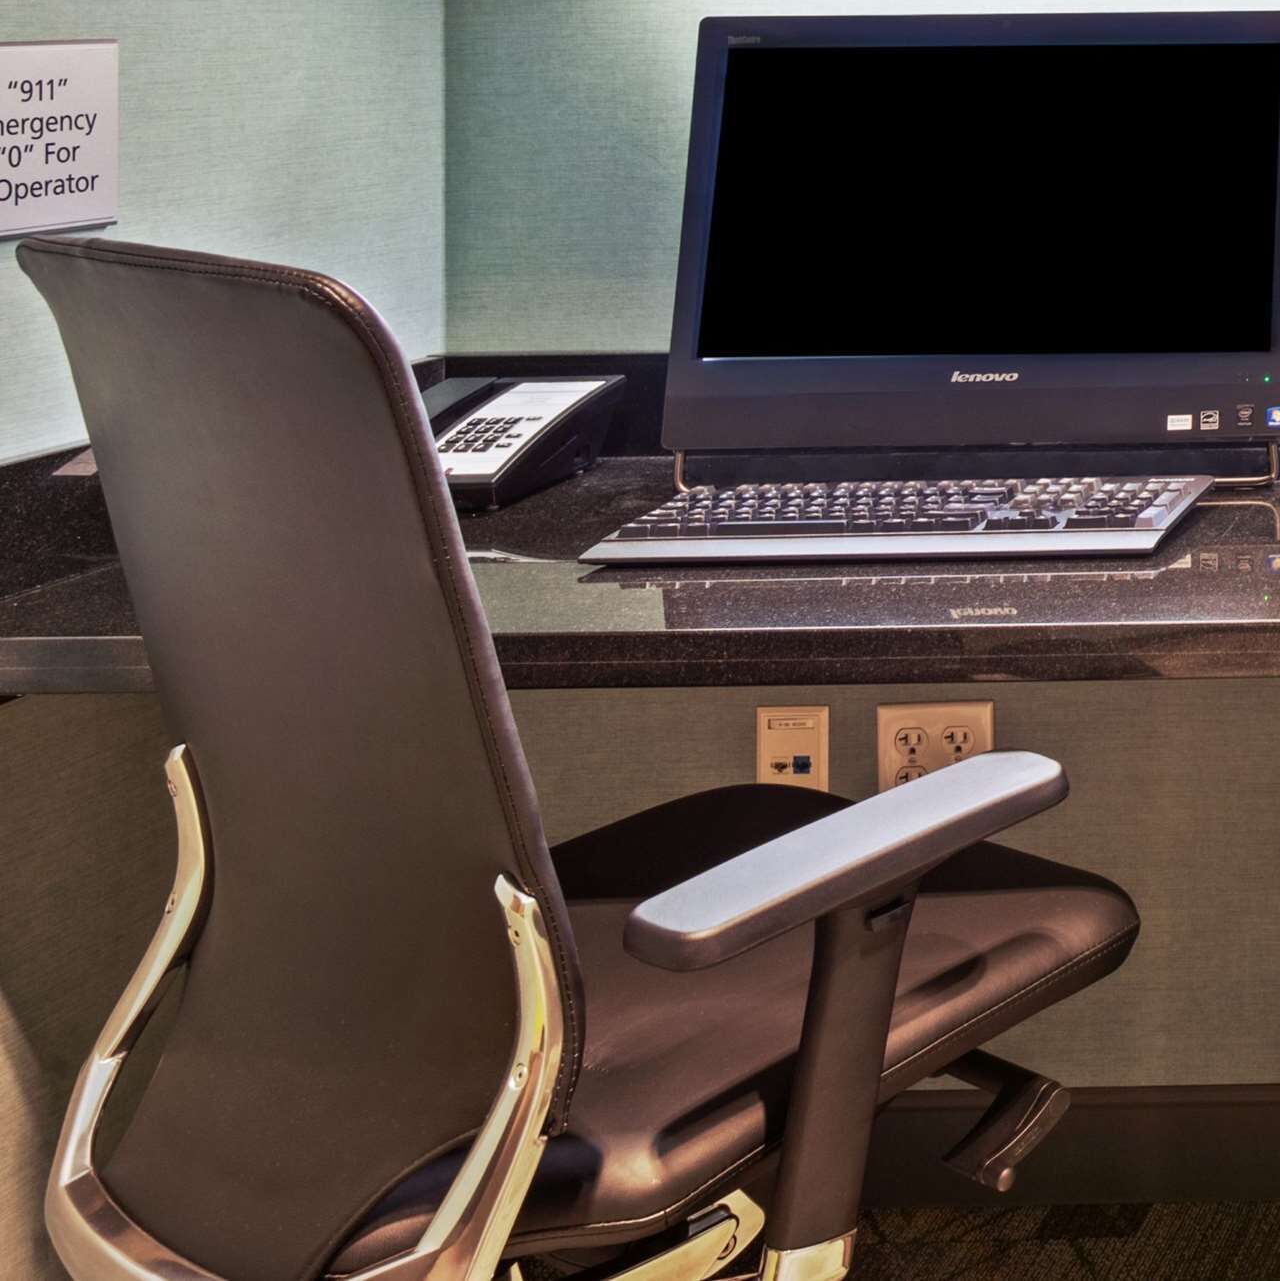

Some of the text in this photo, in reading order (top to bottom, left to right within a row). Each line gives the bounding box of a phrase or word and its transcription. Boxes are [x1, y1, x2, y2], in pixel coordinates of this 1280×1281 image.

[0, 113, 97, 139] ergency
[45, 142, 80, 165] For
[950, 370, 1019, 383] lenovo
